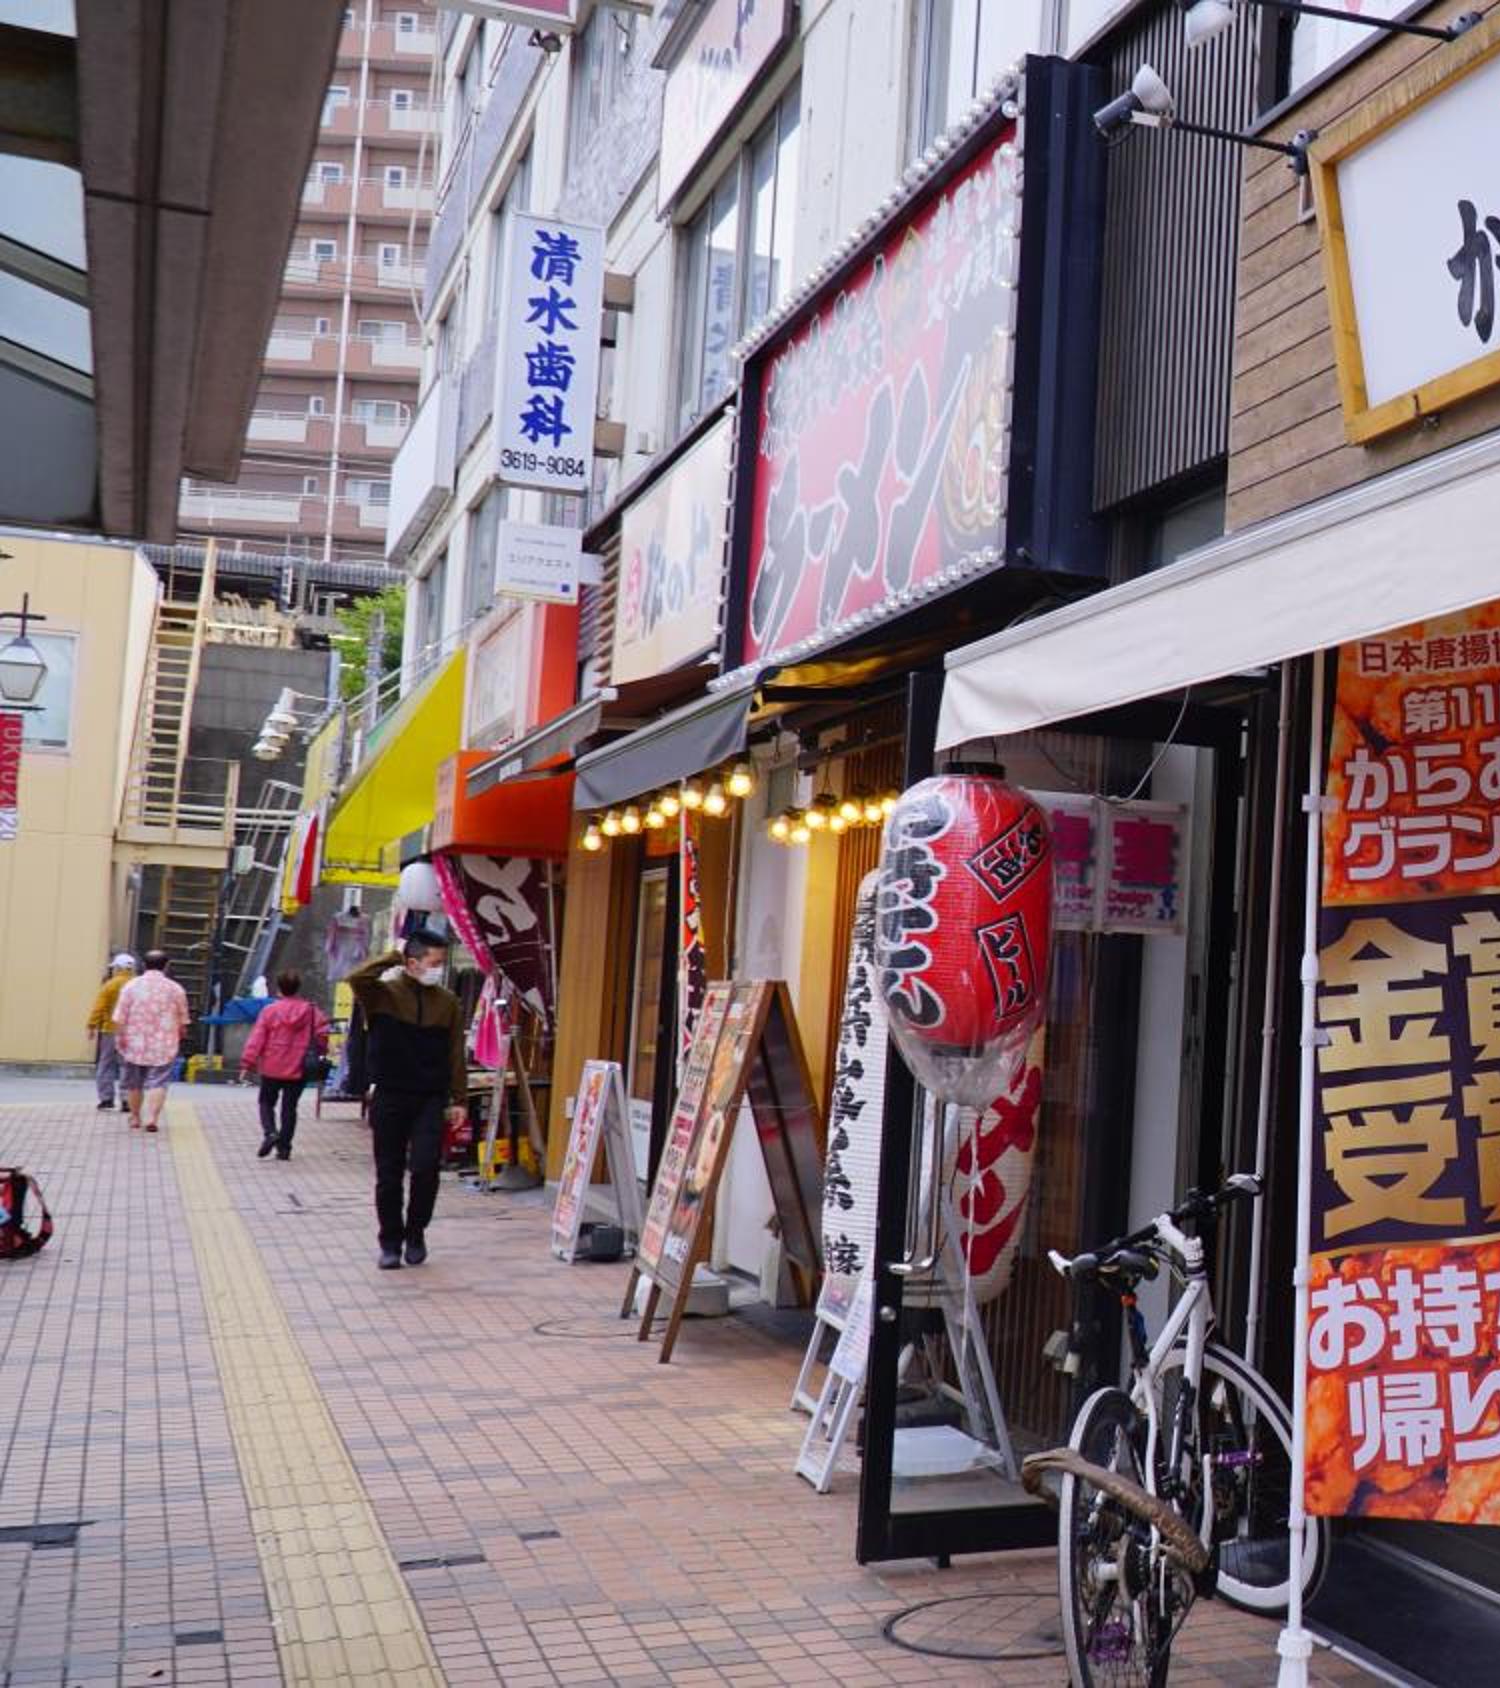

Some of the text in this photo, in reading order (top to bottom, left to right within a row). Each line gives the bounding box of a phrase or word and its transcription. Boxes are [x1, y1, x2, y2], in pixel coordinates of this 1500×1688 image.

[519, 229, 582, 448] 清水歯科
[501, 450, 585, 477] 3619-9084
